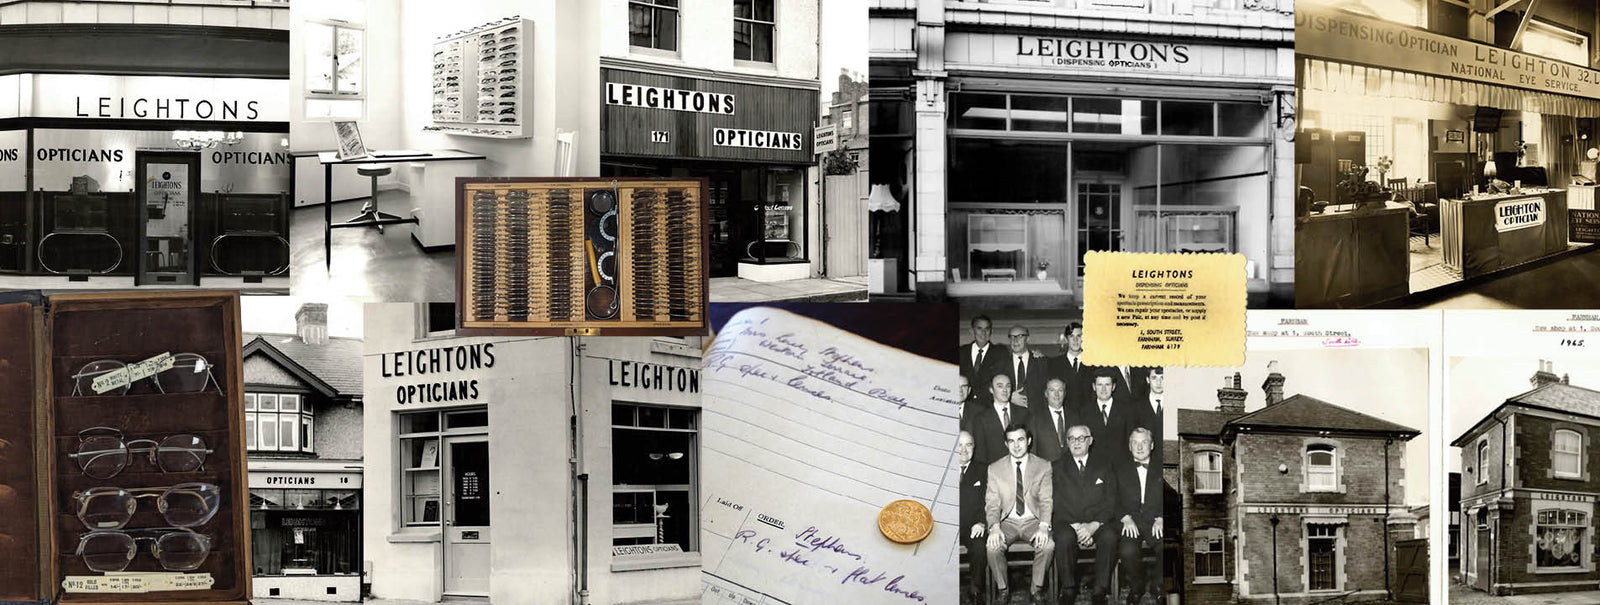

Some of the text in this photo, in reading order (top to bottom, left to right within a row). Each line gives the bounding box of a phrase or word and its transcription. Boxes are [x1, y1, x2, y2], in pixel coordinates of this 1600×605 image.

[1016, 36, 1189, 64] LEIGHTON'S
[1295, 10, 1393, 46] DISPENSING
[1399, 30, 1458, 58] OPTICIAN
[1475, 45, 1570, 79] LEIGHTON
[1057, 58, 1105, 66] DISPENSING
[1108, 59, 1151, 69] OPTICIANS
[1451, 61, 1505, 81] NATIONAL
[1519, 74, 1536, 86] EYE
[608, 83, 735, 114] LEIGHTONS
[76, 96, 259, 120] LEIGHTONS
[653, 131, 669, 143] 171
[716, 128, 801, 149] OPTICIANS
[37, 148, 124, 162] OPTICIANS
[1499, 201, 1540, 218] LEIGHTON
[1504, 212, 1538, 226] OPTICIAN
[1132, 270, 1193, 279] LEIGHTONS
[381, 342, 495, 378] LEIGHTONS
[396, 379, 479, 405] OPTICIANS
[266, 476, 315, 485] OPTICIANS
[717, 497, 744, 512] Laid Off
[1540, 493, 1586, 502] LEIGHTONS
[613, 545, 654, 556] LEIGHTONS
